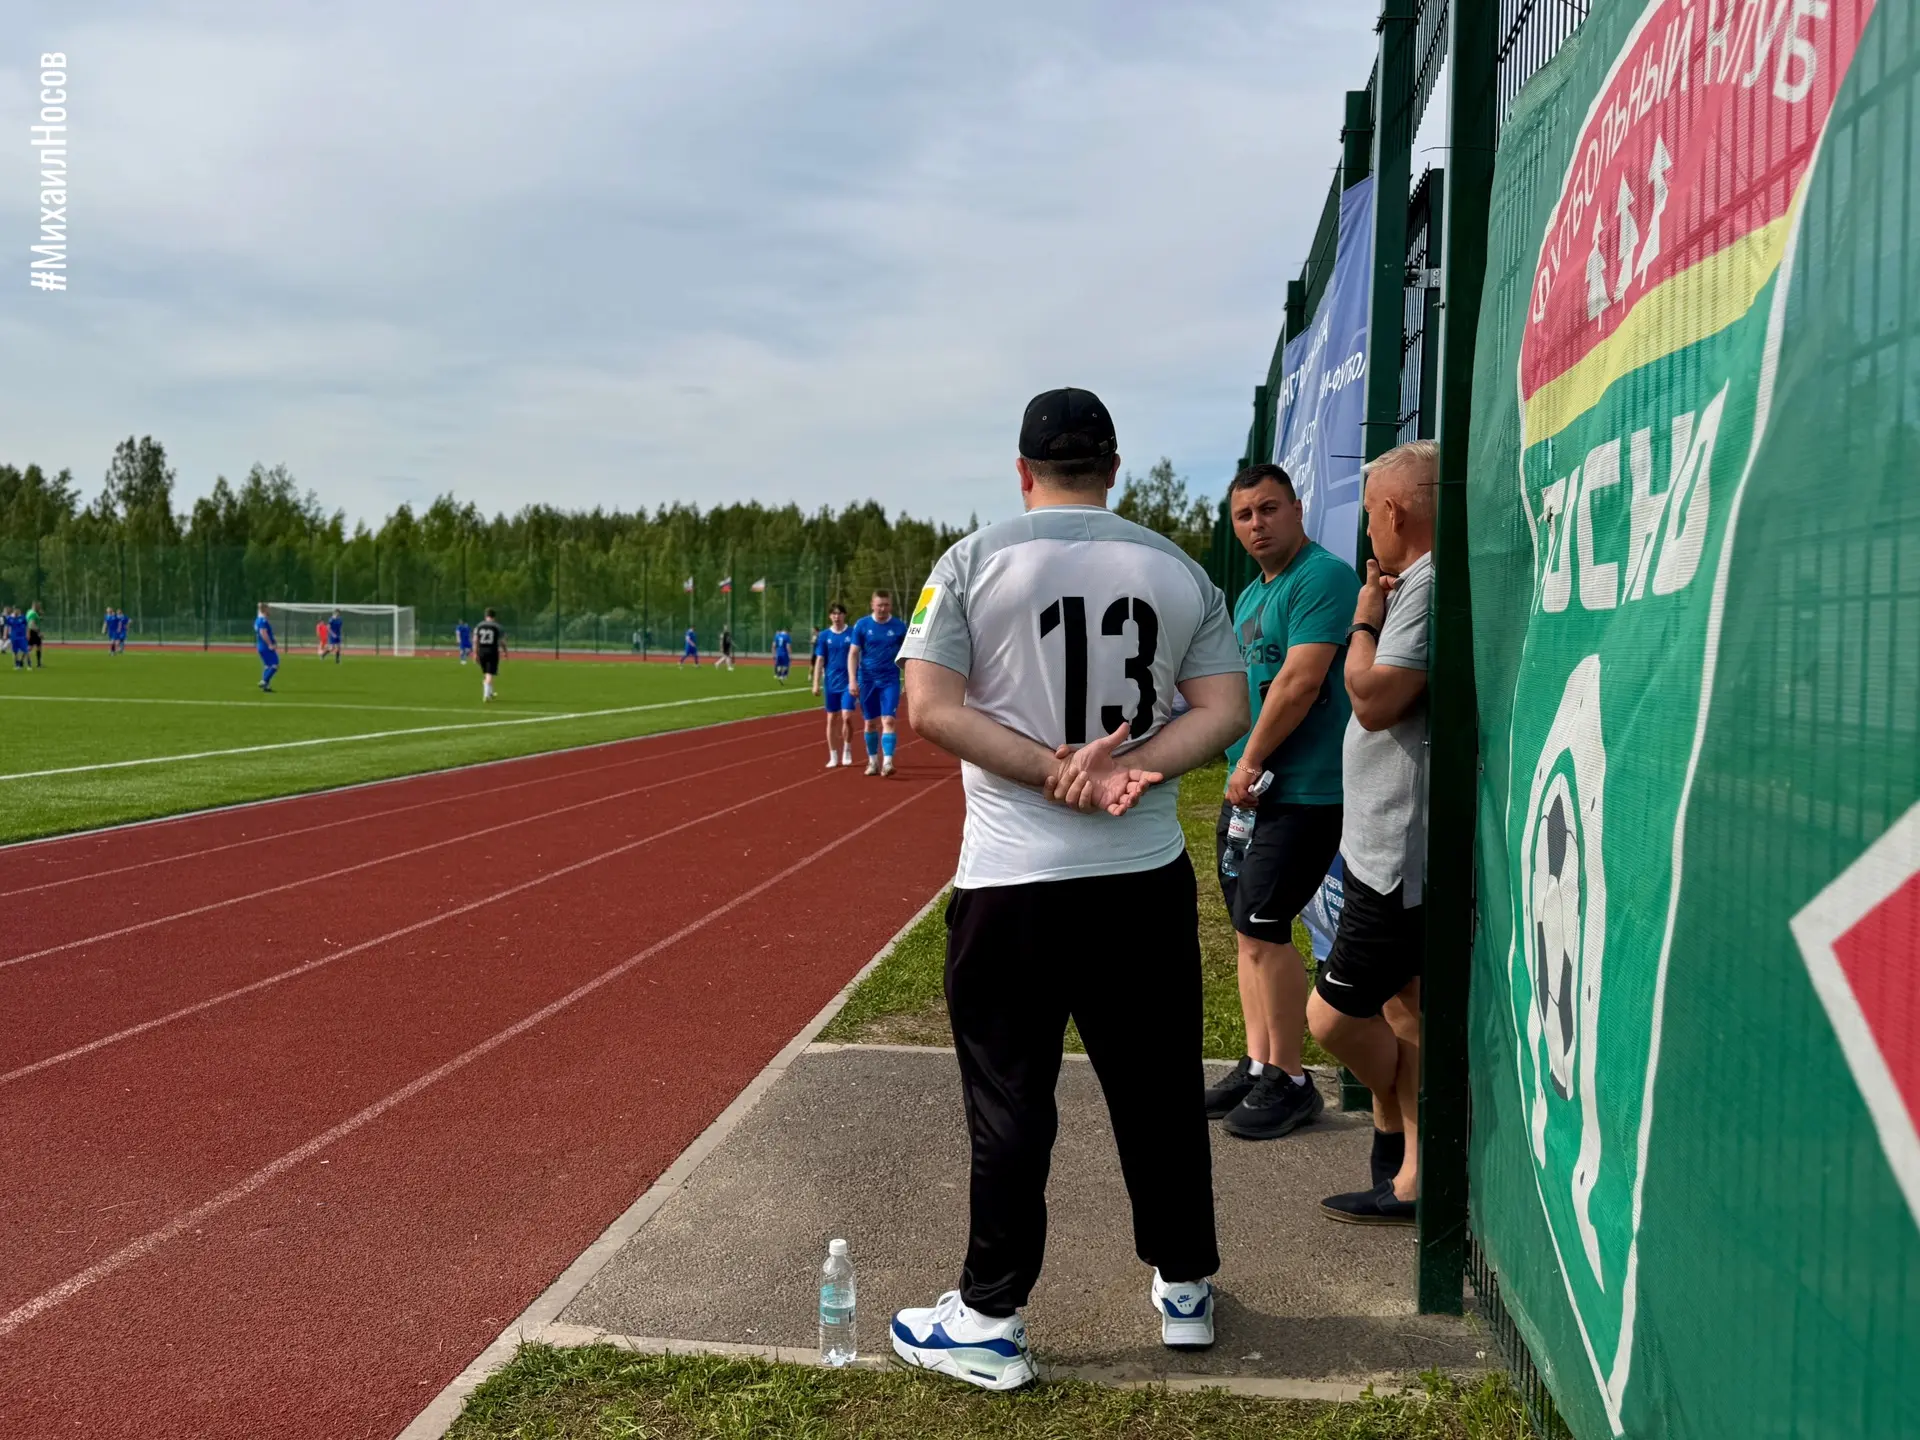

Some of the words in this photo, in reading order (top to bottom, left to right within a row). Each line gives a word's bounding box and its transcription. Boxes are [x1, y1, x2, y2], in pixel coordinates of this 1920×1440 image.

[1532, 0, 1696, 323] ФУТБОЛЬНЫЙ
[1703, 0, 1829, 104] КЛУБ
[479, 628, 495, 645] 23
[1039, 596, 1159, 745] 13
